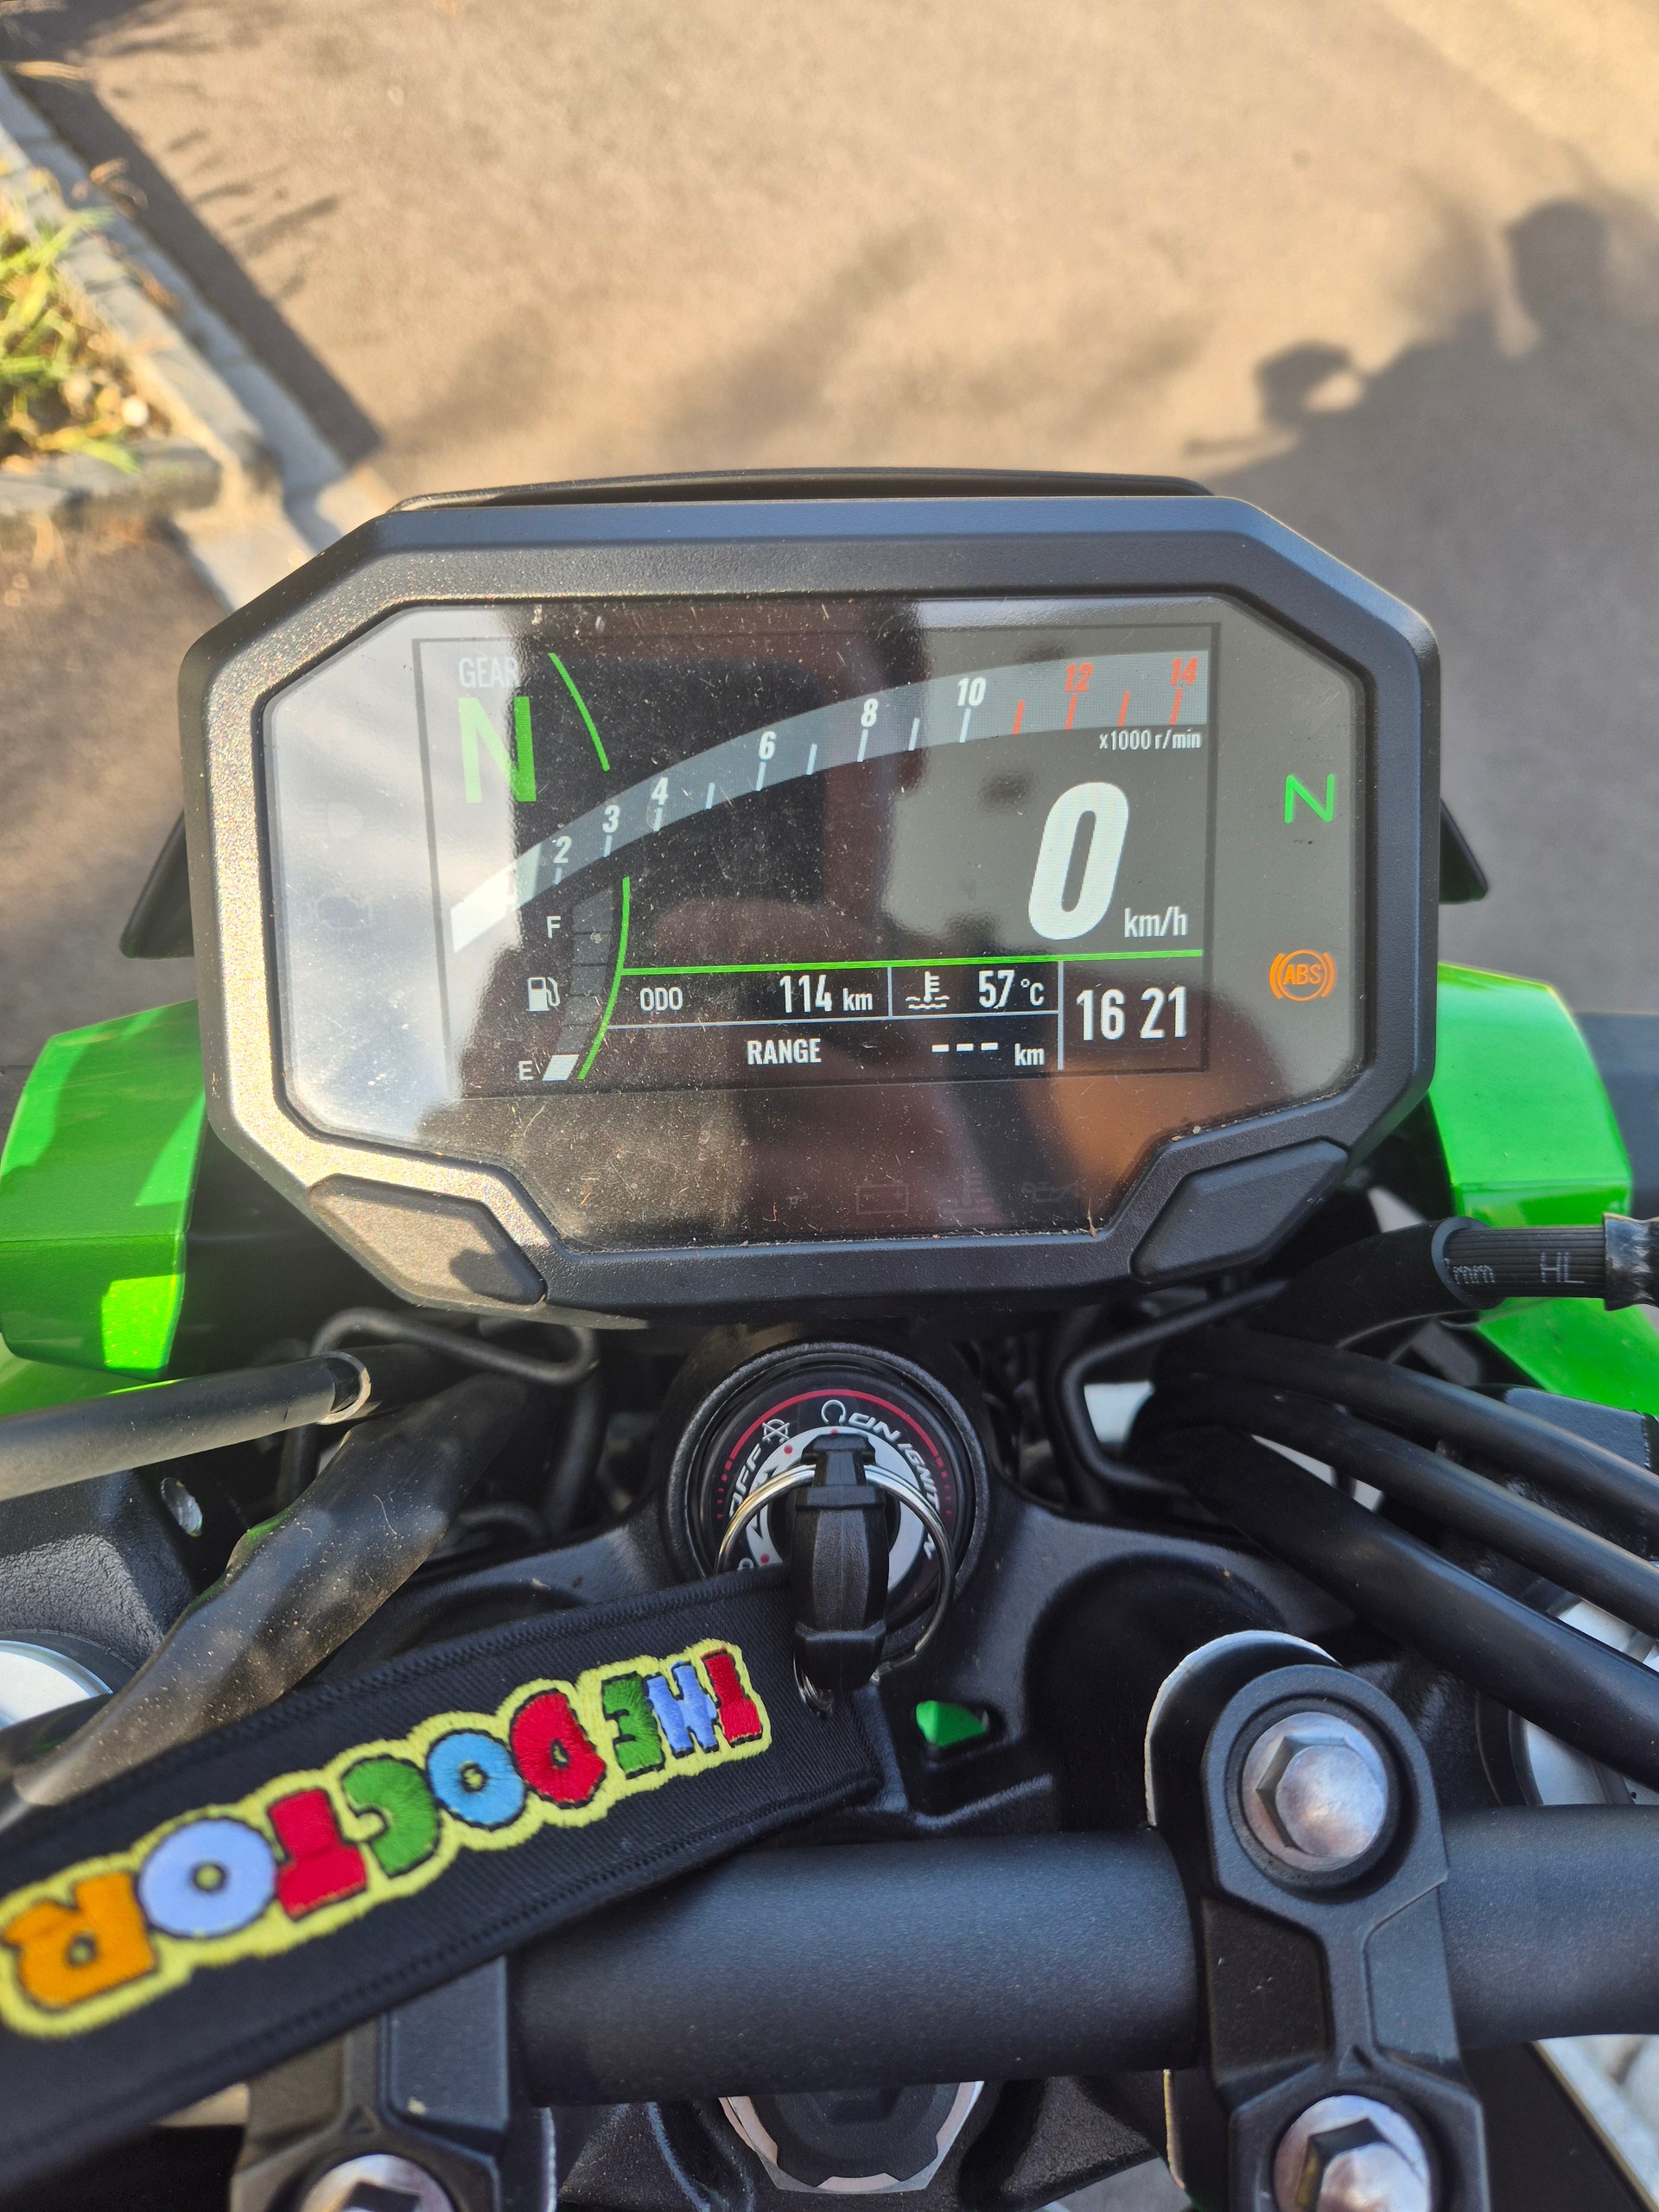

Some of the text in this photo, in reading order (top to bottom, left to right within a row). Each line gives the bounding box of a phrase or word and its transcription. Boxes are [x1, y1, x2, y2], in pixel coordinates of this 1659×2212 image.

[459, 658, 520, 689] GEAR
[1065, 664, 1093, 691] 12
[1170, 657, 1198, 685] 14
[957, 677, 986, 706] 10
[861, 699, 879, 728] 8
[458, 696, 537, 804] N
[759, 731, 777, 760] 6
[1099, 728, 1202, 750] x1000 r/min
[652, 778, 669, 804] 4
[1285, 774, 1335, 823] N
[602, 808, 620, 833] 3
[554, 836, 569, 864] 2
[1028, 782, 1128, 940] 0
[547, 916, 562, 938] F
[1124, 906, 1188, 938] km/h
[978, 969, 1015, 1008] 57
[1283, 964, 1322, 986] ABS
[639, 975, 874, 1014] ODO 114 km
[1077, 986, 1187, 1040] 16 21
[747, 1038, 1045, 1066] RANGE km
[518, 1061, 534, 1080] E
[1444, 1257, 1496, 1285] mm
[848, 1412, 901, 1442] ON
[3, 1648, 765, 2010] THE DOCTOR
